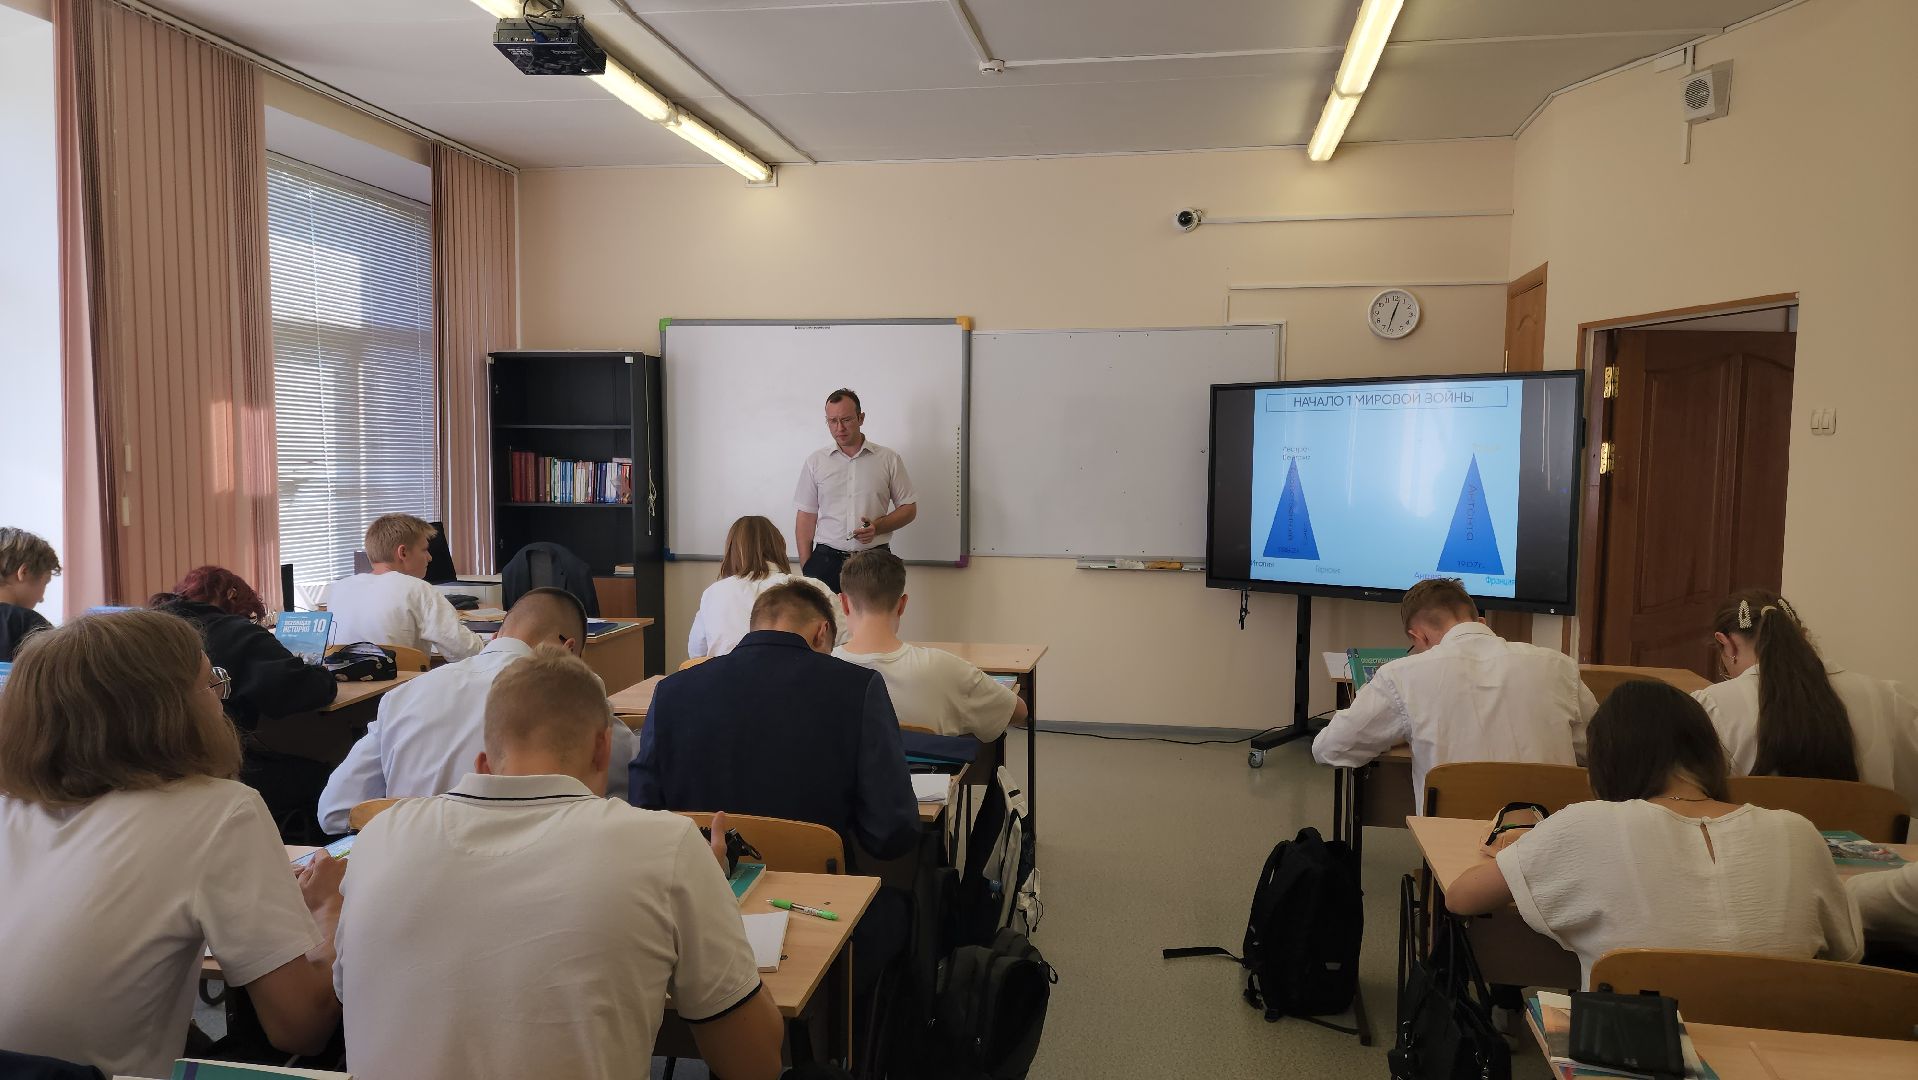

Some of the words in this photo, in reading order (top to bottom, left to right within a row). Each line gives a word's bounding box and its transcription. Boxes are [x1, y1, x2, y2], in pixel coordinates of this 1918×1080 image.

[1293, 395, 1344, 407] НАЧАЛО
[1354, 391, 1421, 406] МИРОВОЙ
[1424, 390, 1474, 404] ВОЙНЫ
[313, 618, 327, 633] 10
